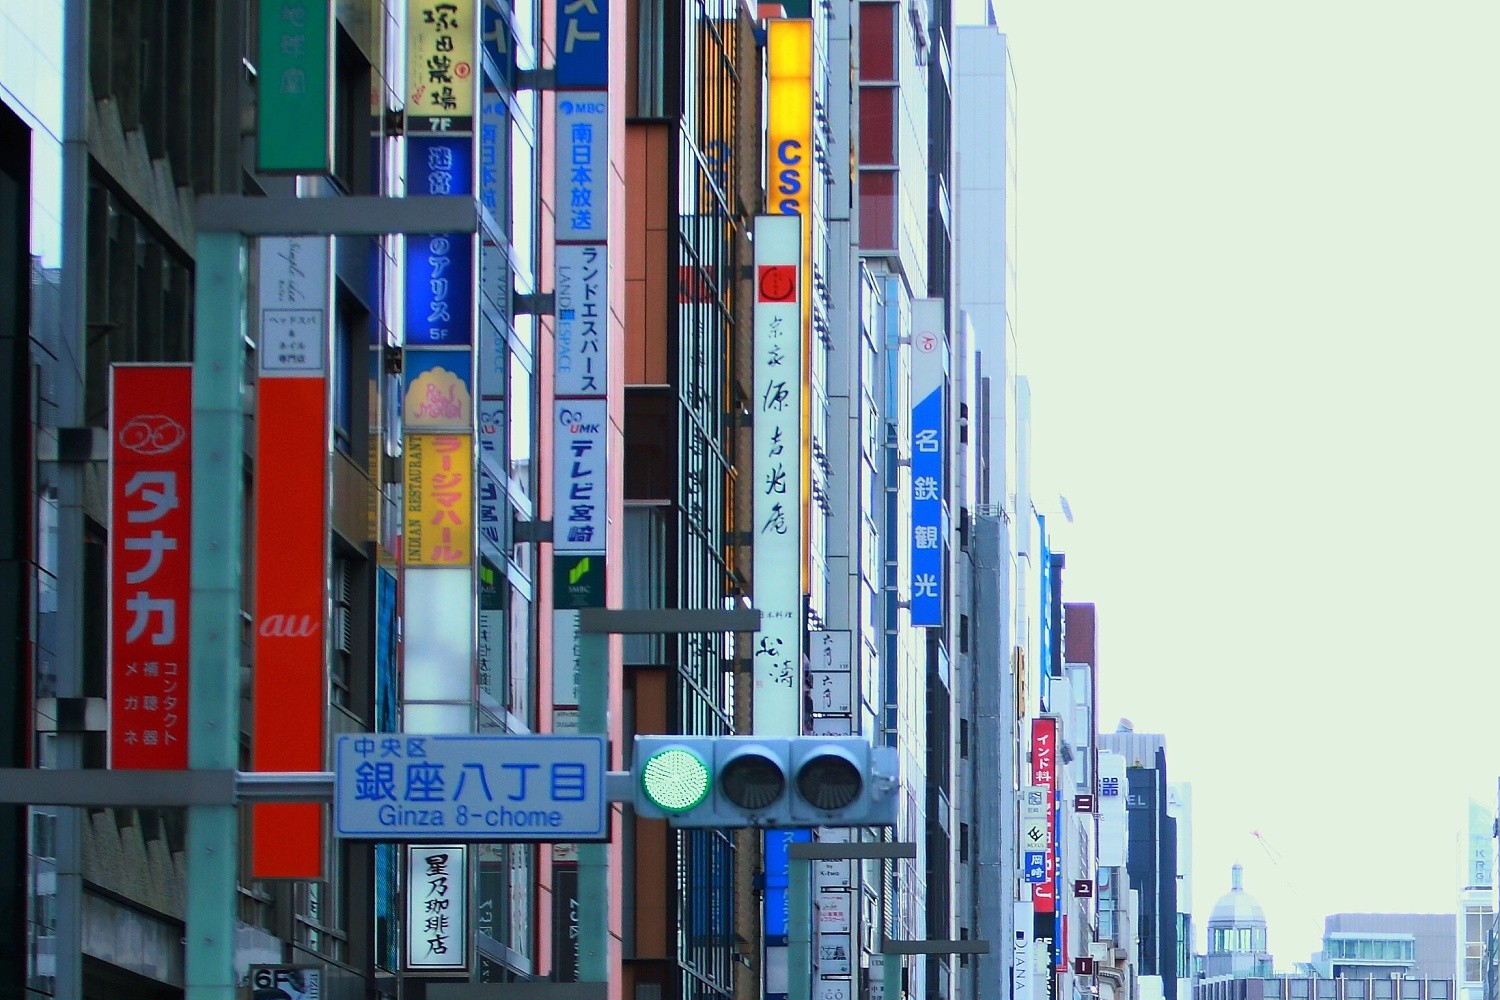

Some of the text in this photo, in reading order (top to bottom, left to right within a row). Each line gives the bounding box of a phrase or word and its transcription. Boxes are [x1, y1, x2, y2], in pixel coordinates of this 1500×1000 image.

[428, 118, 451, 131] 7F
[575, 103, 604, 114] MBC
[571, 122, 593, 230] 南日本放送
[570, 424, 599, 433] UMK
[407, 436, 423, 562] INDIAN RESTAURANT
[567, 439, 594, 543] テレビ宮崎
[914, 429, 939, 599] 名鉄観光
[124, 470, 179, 646] タナカ
[259, 613, 320, 638] au
[124, 661, 138, 745] メガネ
[143, 661, 160, 746] 補聴器
[163, 661, 178, 744] コンタクト
[353, 737, 428, 758] 中央区
[355, 762, 586, 802] 銀座八丁目
[378, 804, 562, 827] Ginza 8-chome
[422, 853, 451, 960] 星乃珈琲店
[1015, 940, 1028, 991] DIANA
